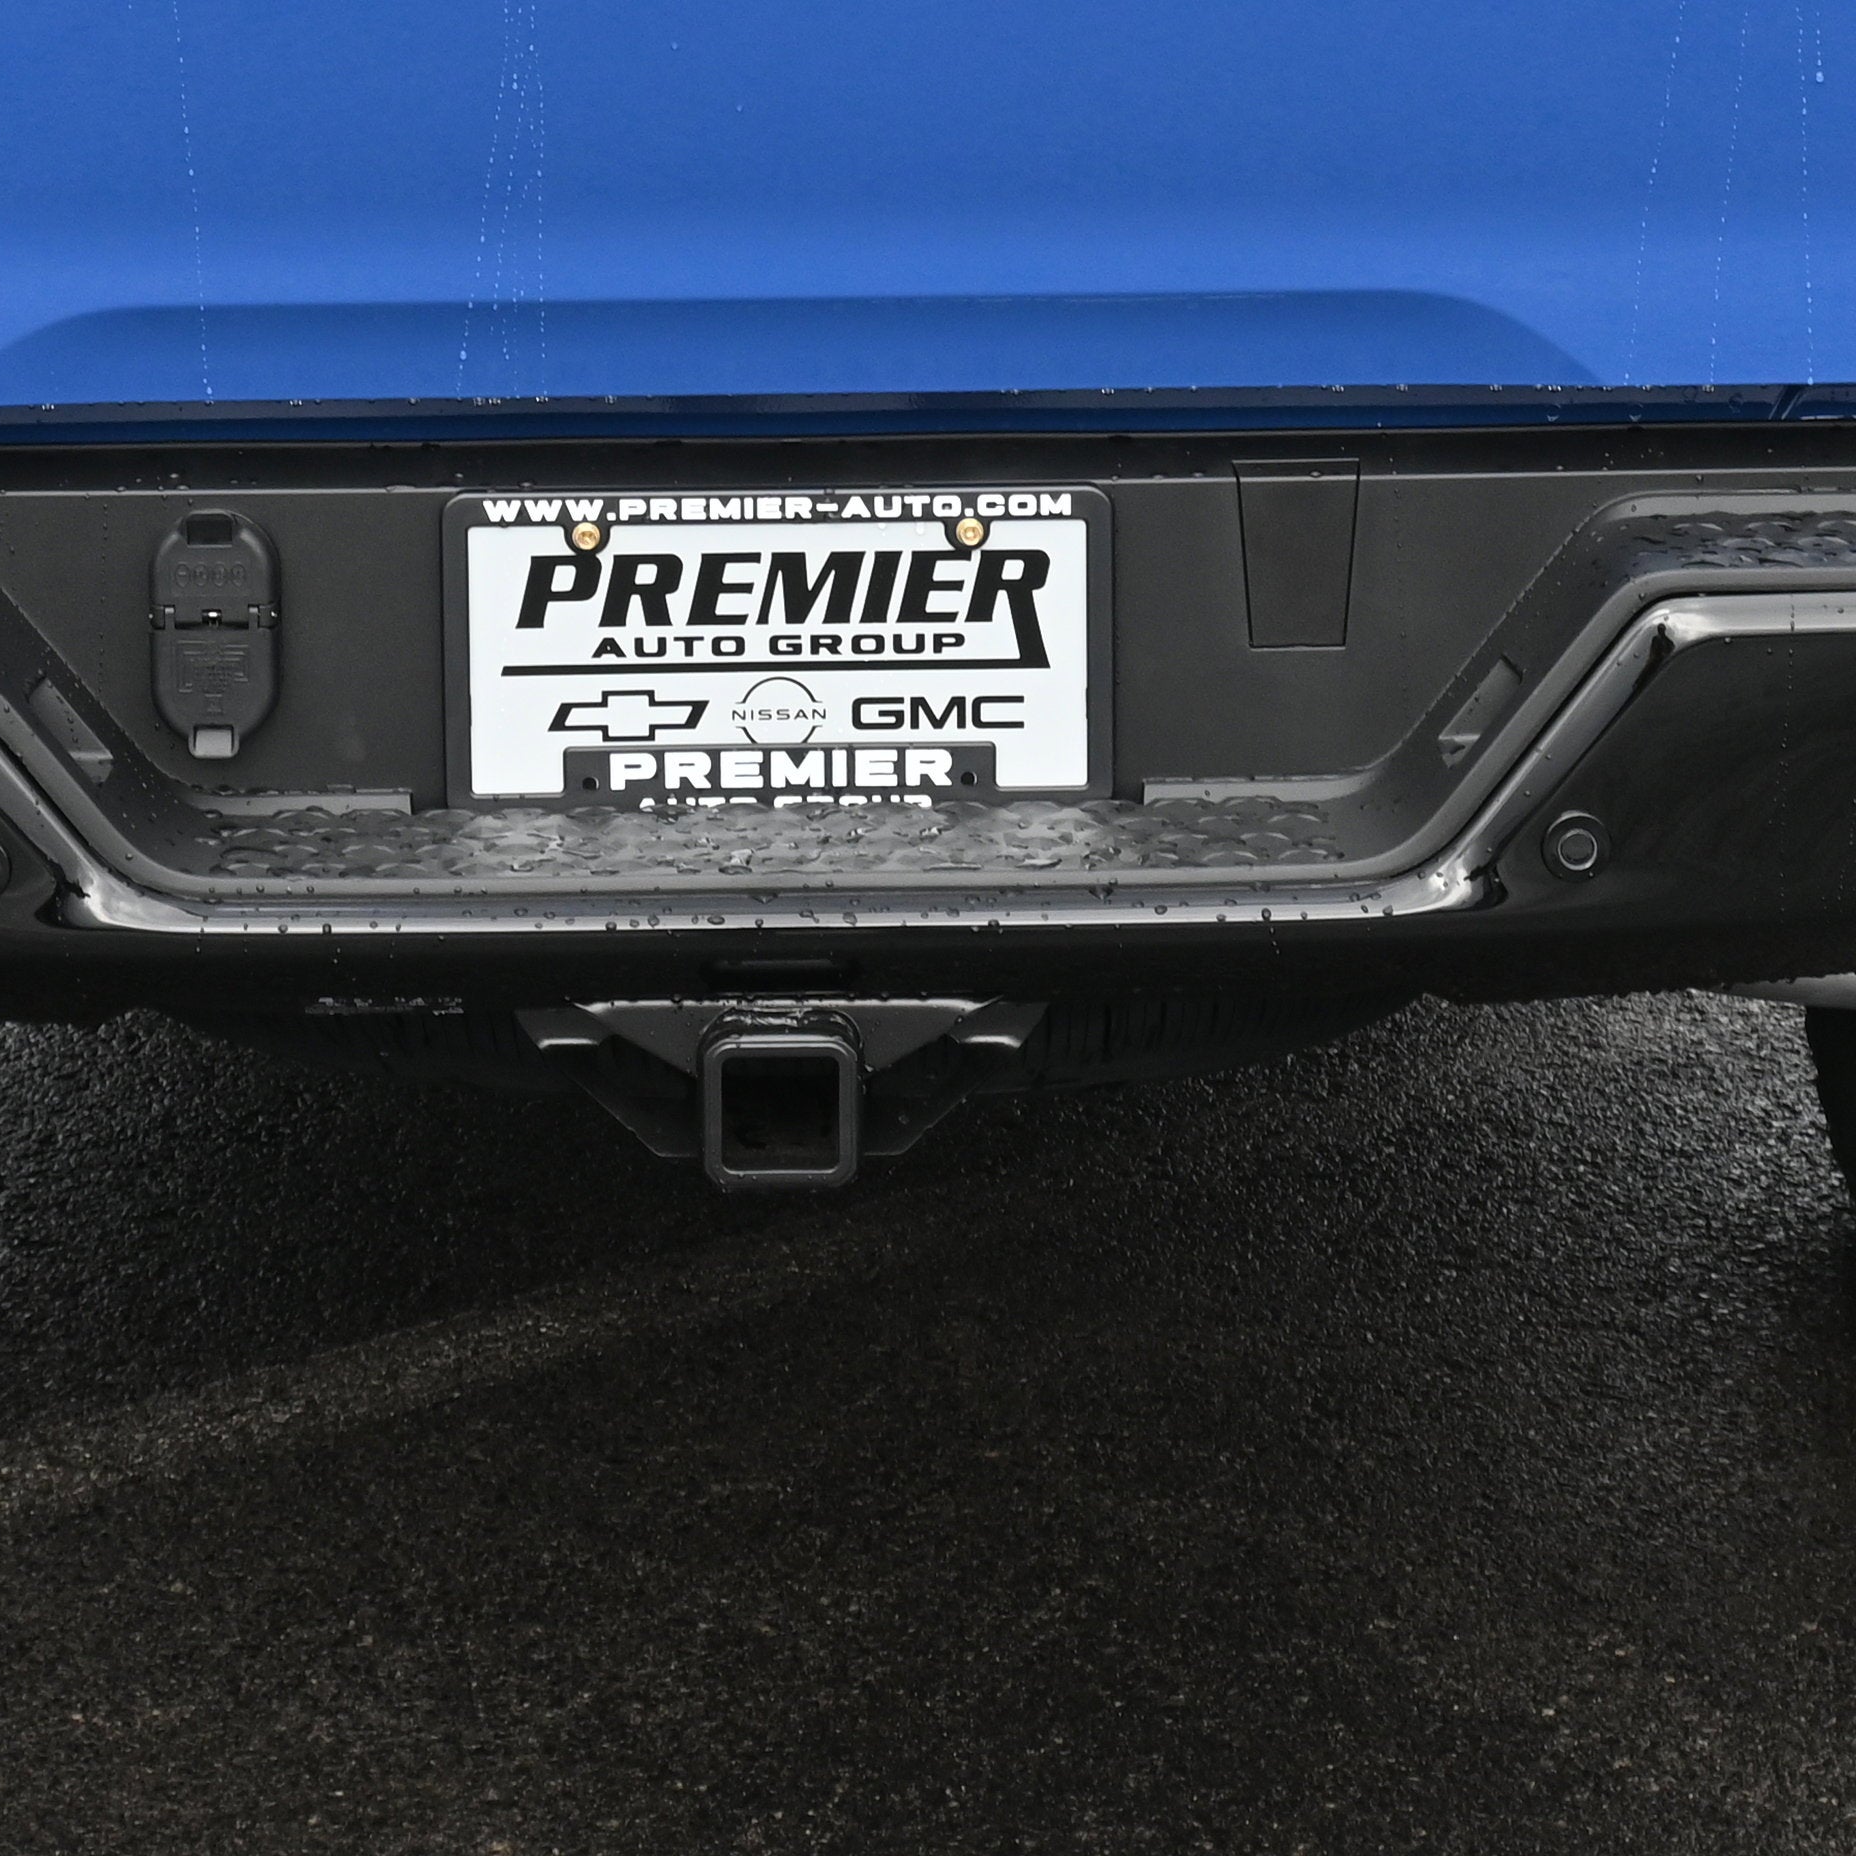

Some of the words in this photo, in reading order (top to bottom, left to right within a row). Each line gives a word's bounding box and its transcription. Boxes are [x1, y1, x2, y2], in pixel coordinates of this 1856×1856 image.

[482, 492, 1073, 523] WWW.PREMIER-AUTO.COM
[515, 549, 1051, 634] PREMIER
[592, 635, 747, 658] AUTO
[769, 632, 966, 656] GROUP
[732, 708, 827, 721] NISSAN
[851, 695, 1026, 730] GMC
[609, 748, 953, 791] PREMIER
